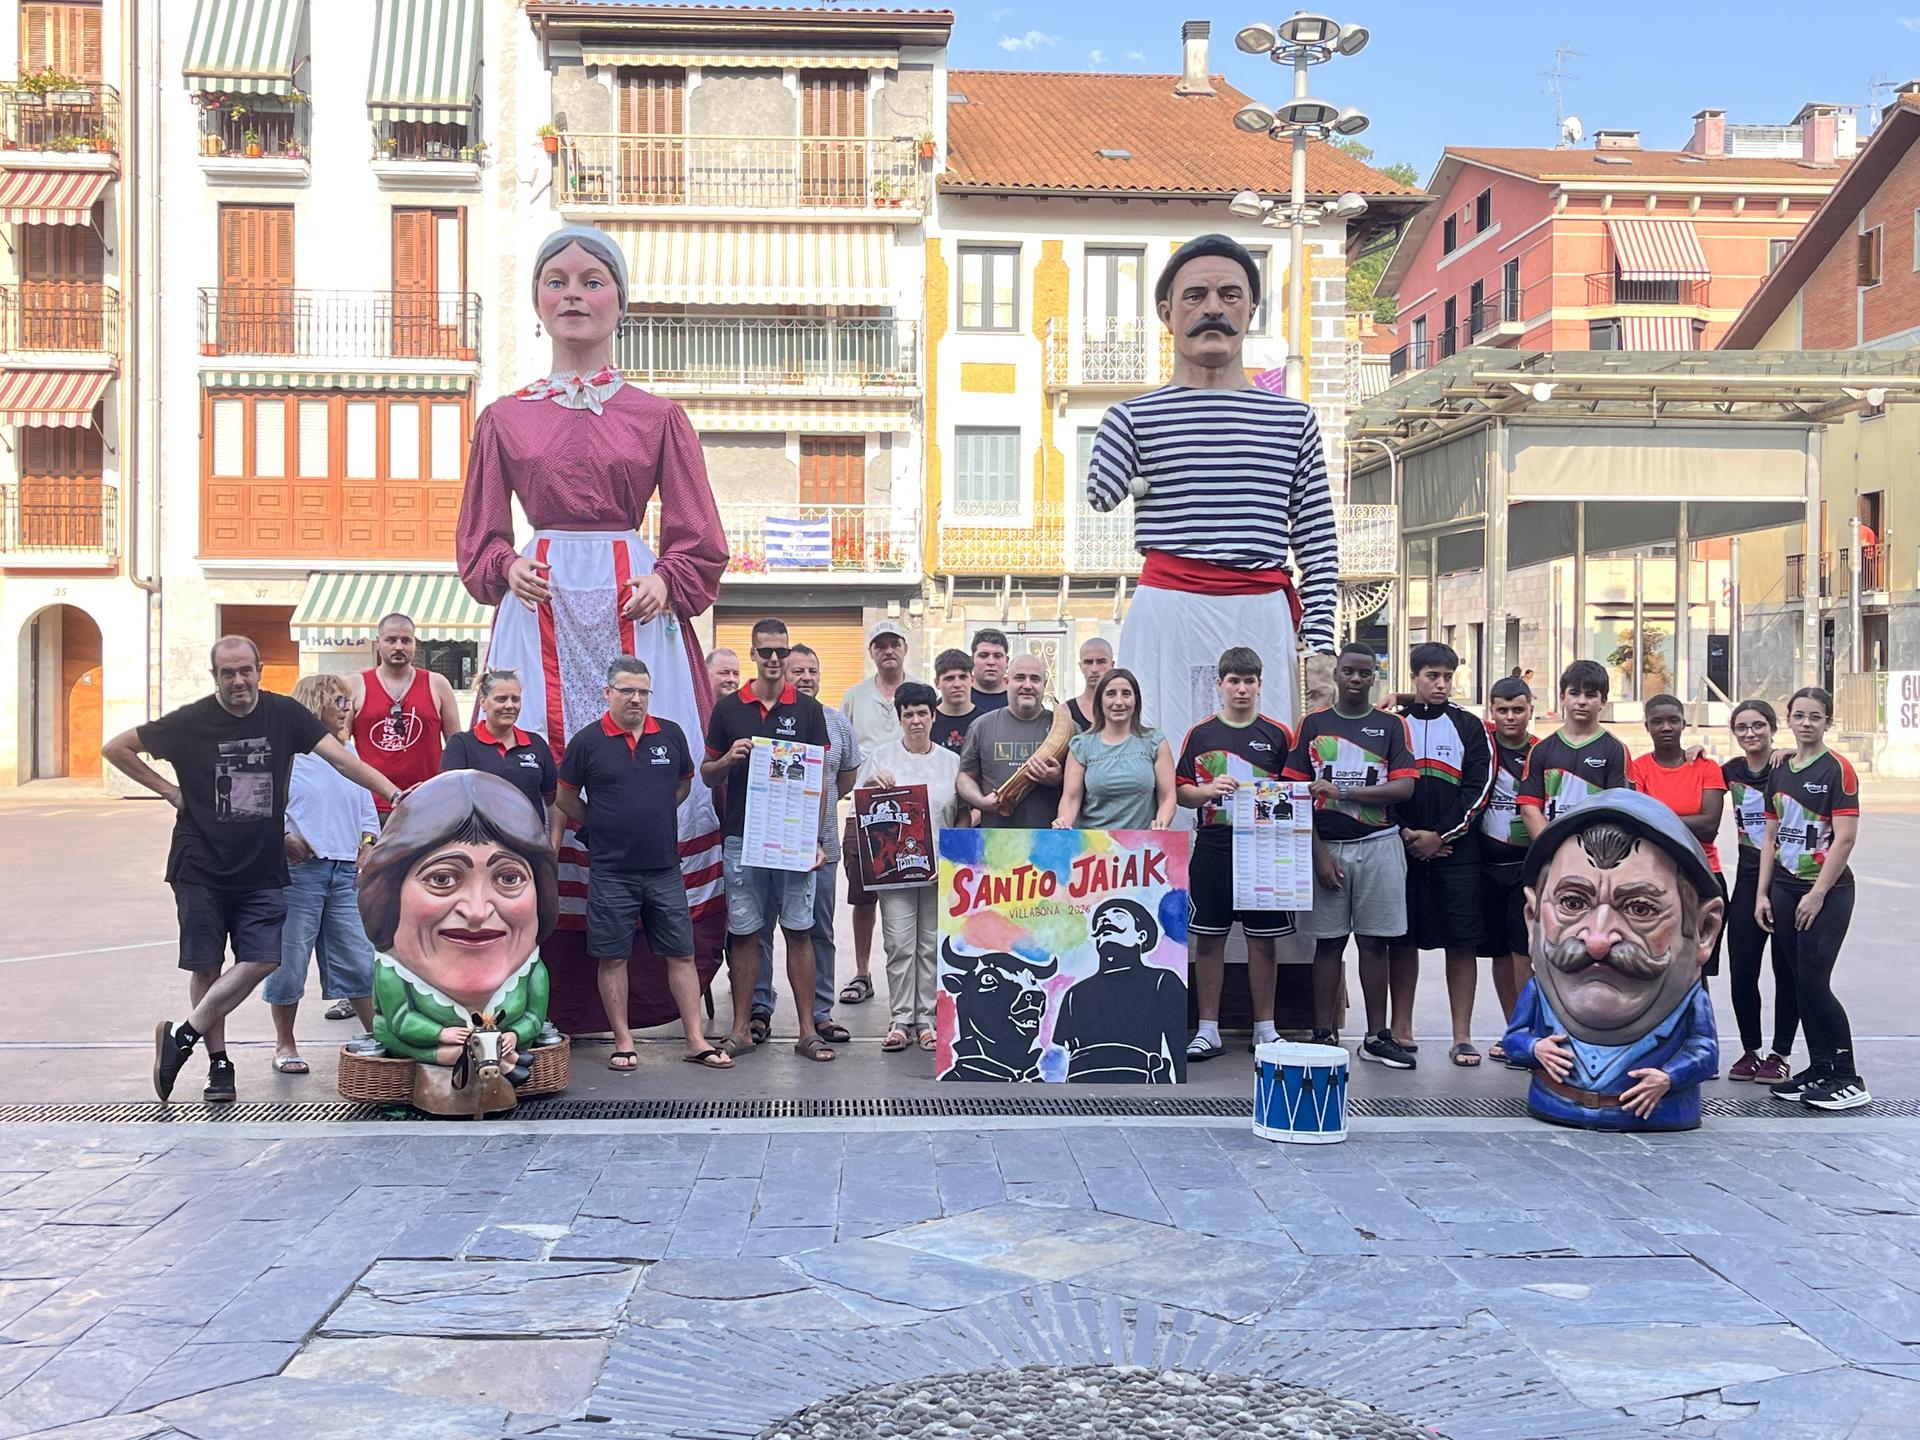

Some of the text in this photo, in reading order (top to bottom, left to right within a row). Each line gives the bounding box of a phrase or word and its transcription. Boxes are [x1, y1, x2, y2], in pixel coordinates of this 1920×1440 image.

[53, 587, 67, 597] 35
[255, 588, 268, 599] 37
[1067, 904, 1092, 915] 2026
